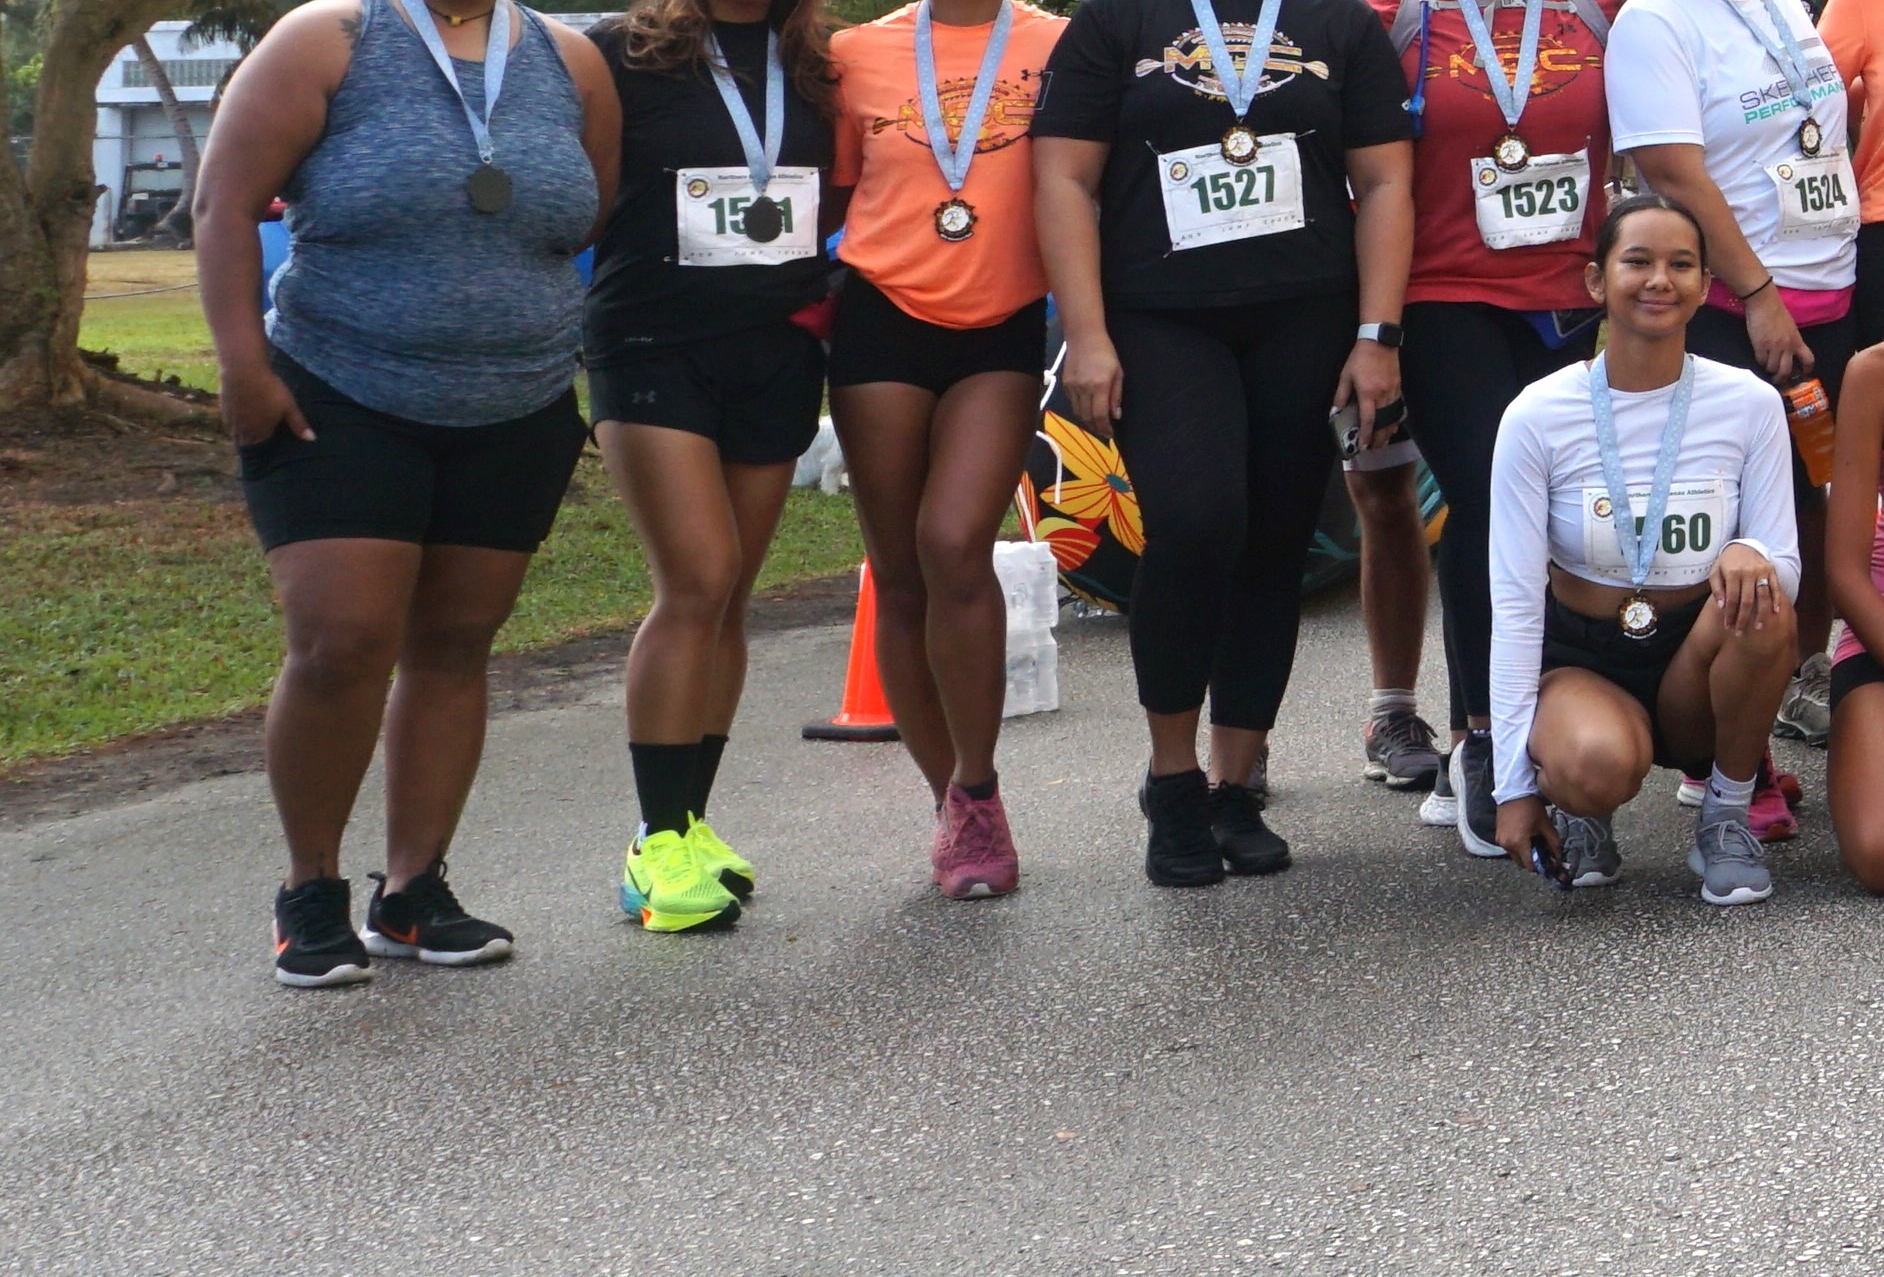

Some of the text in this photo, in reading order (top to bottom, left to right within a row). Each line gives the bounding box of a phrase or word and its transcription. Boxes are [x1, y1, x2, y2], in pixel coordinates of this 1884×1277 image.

[1190, 164, 1276, 215] 1527
[1496, 176, 1580, 219] 1523
[1795, 173, 1848, 213] 1524
[707, 196, 793, 235] 151
